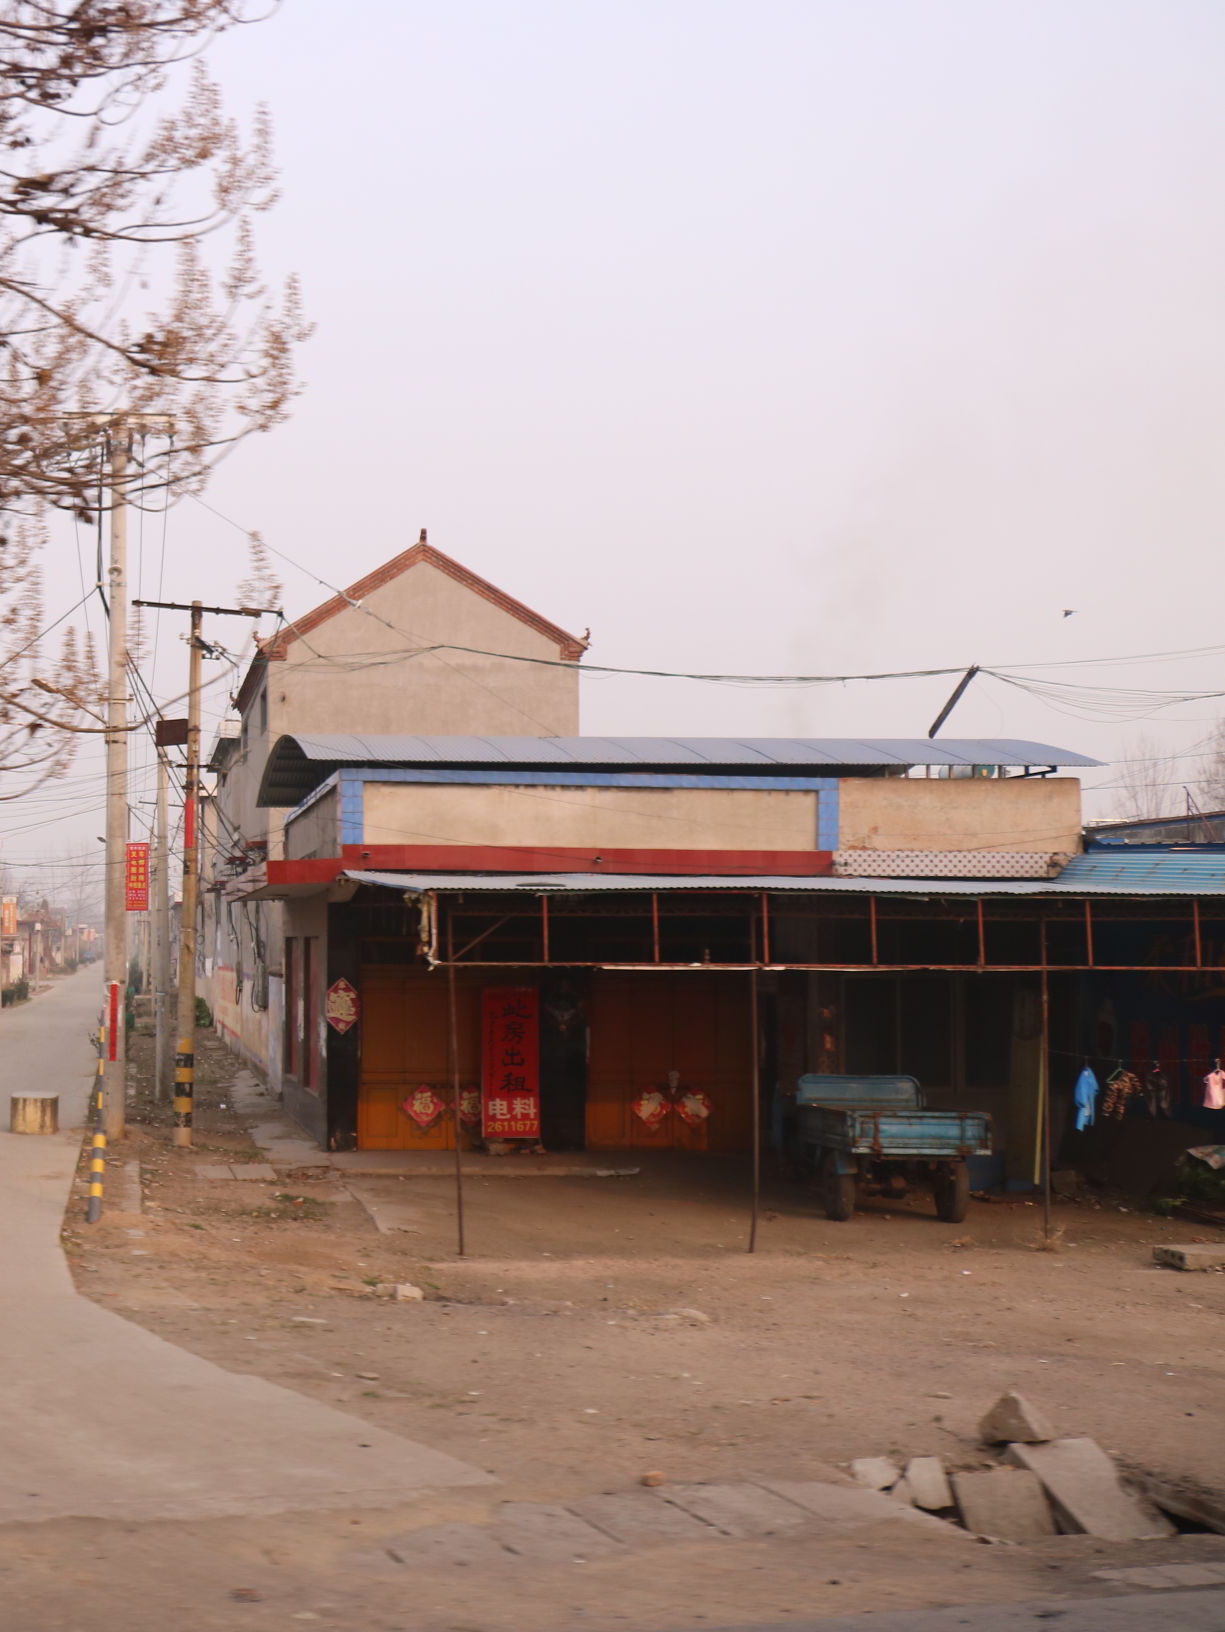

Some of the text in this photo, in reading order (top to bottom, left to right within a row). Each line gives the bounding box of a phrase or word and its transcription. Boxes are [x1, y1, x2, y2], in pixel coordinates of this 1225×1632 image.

[500, 999, 533, 1093] 此房出租
[412, 1091, 434, 1114] 福
[487, 1097, 537, 1120] 电料
[487, 1121, 539, 1133] 2611677
